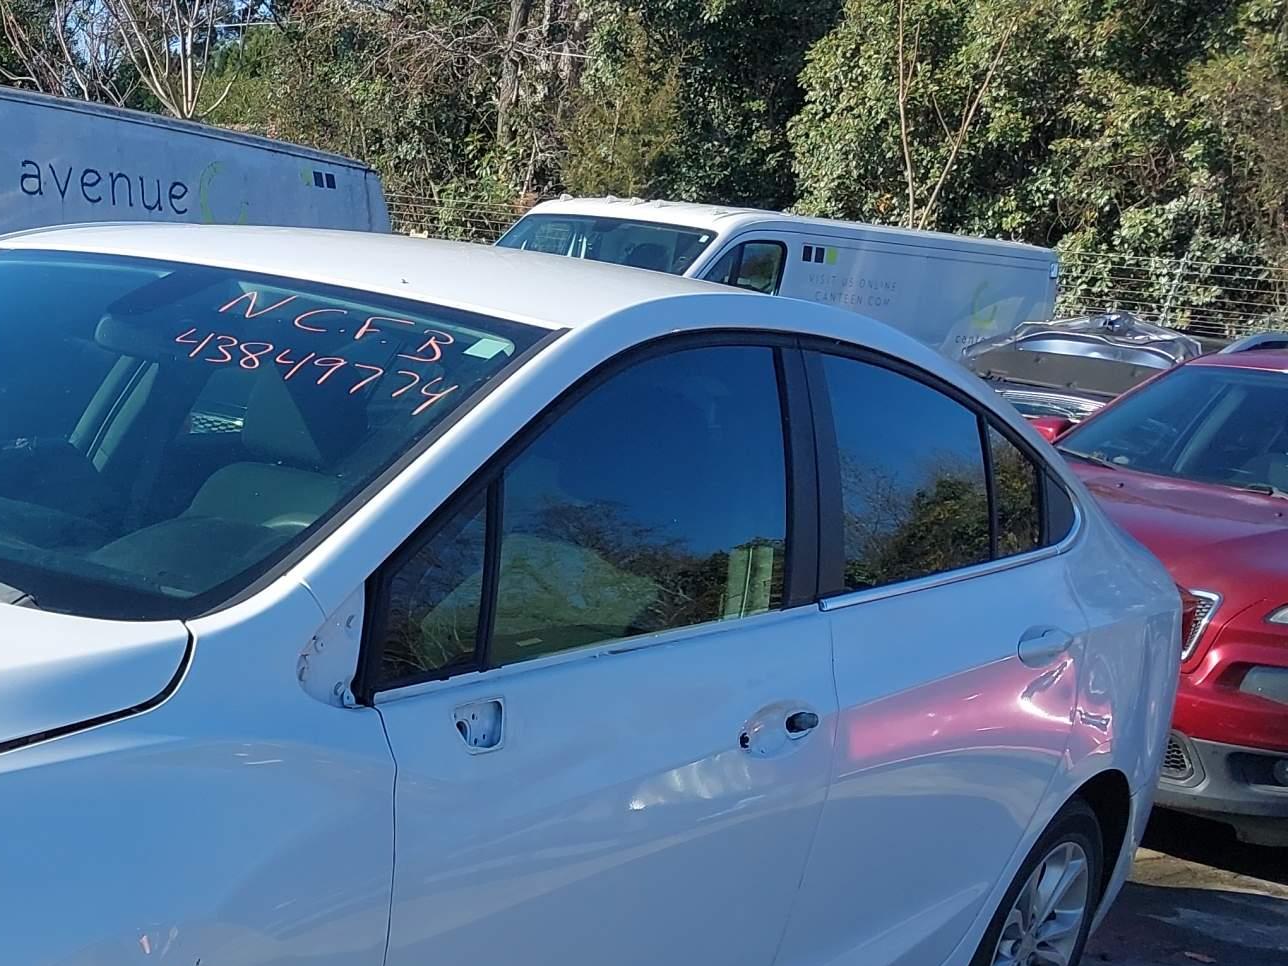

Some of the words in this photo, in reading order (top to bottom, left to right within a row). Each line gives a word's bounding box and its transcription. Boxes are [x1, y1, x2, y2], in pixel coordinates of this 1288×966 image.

[19, 159, 189, 215] avenue
[808, 273, 838, 286] VISIT
[841, 278, 854, 289] US
[859, 278, 897, 292] ONLINE
[175, 328, 459, 415] 43849774
